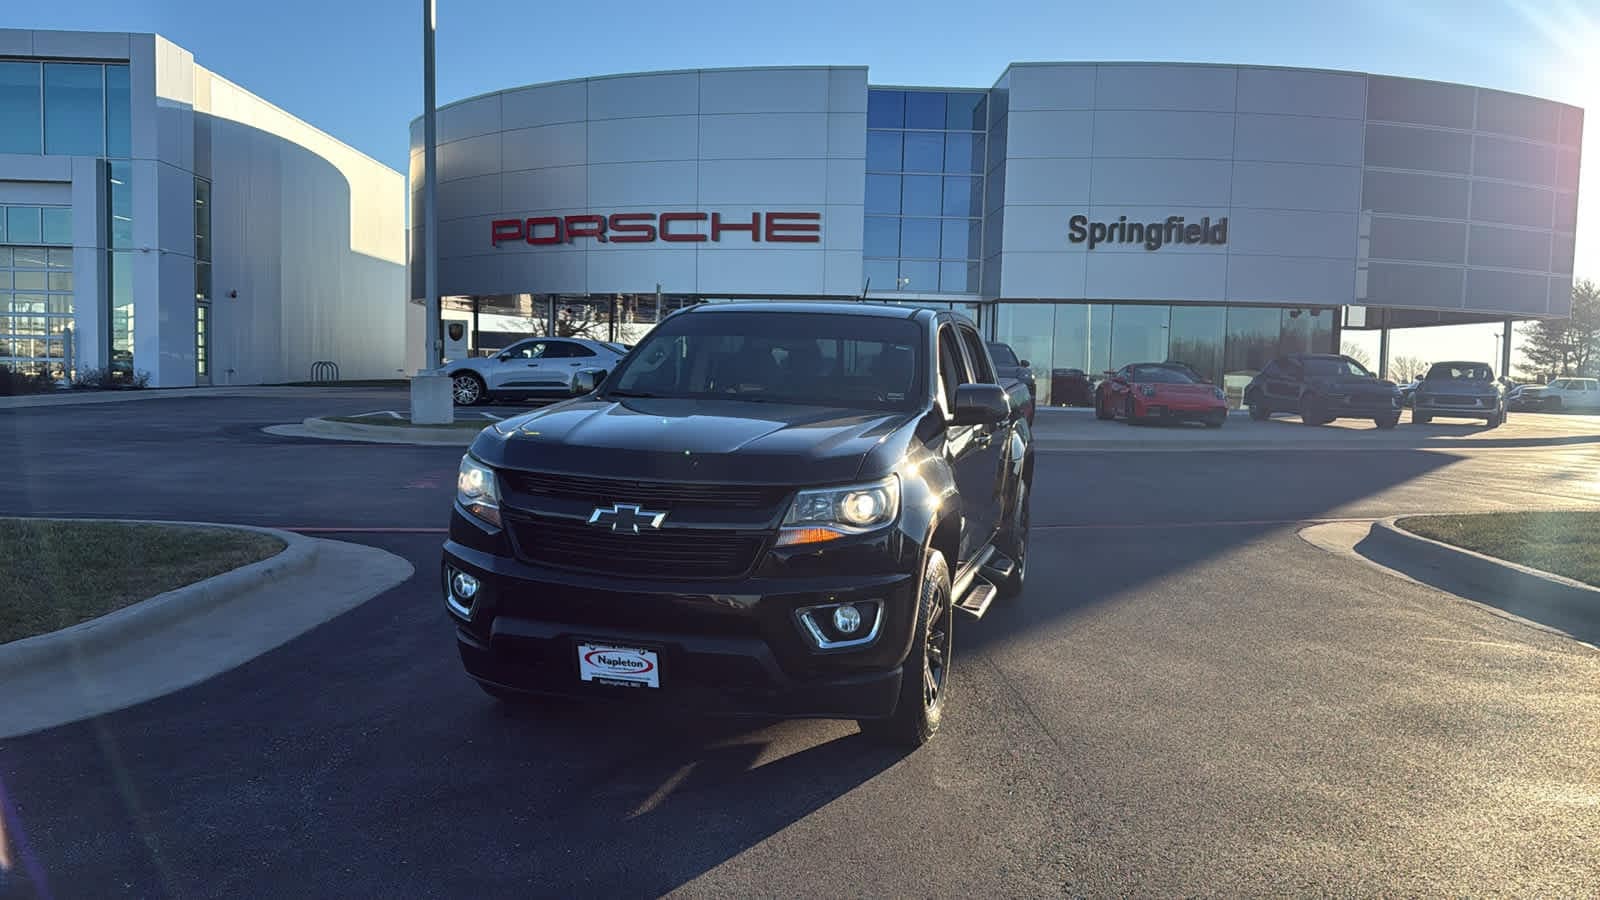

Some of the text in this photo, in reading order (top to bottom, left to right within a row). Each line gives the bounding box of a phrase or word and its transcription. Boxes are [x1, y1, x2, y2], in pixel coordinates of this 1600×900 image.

[492, 212, 820, 247] PORSCHE
[1068, 215, 1228, 250] Springfield
[597, 655, 644, 668] Napleton
